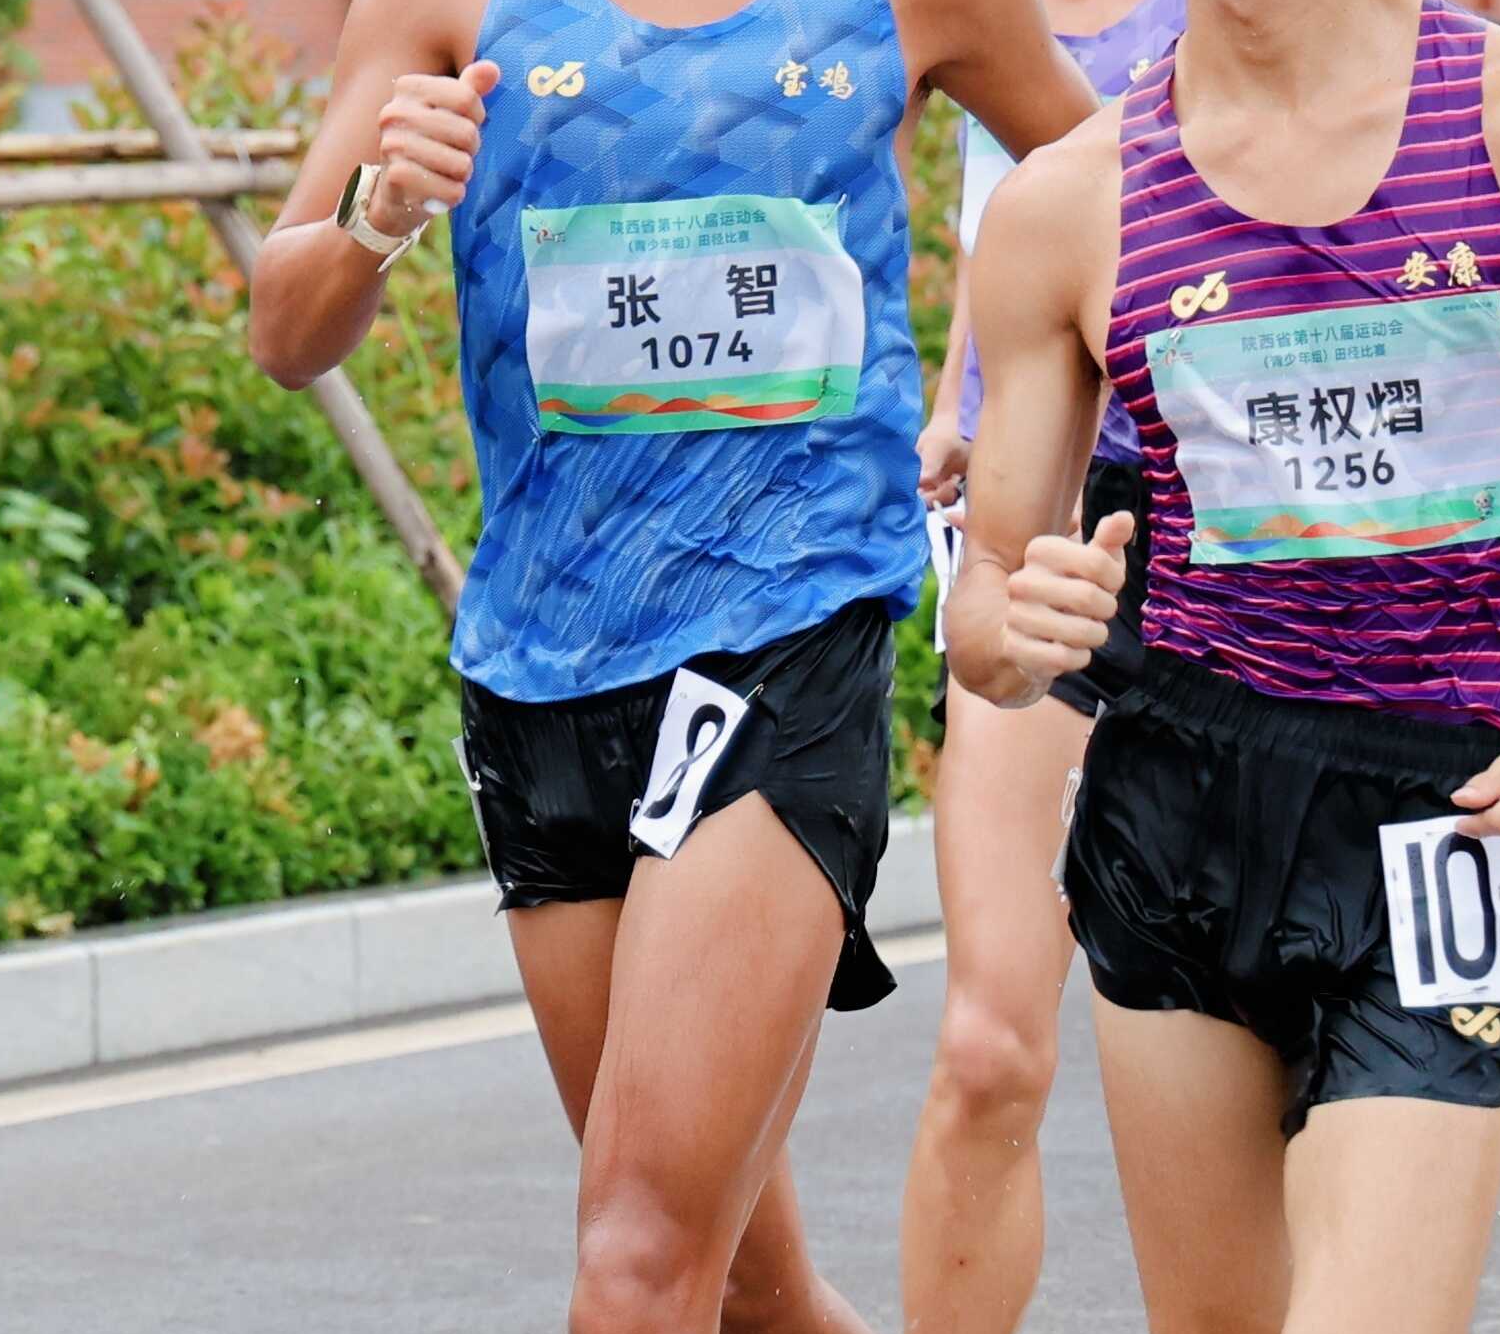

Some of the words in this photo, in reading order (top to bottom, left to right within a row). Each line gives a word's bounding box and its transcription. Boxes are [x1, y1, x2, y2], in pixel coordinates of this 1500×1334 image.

[773, 59, 858, 101] 宝鸡
[609, 209, 768, 236] 陕西省第十八届运动会
[1396, 241, 1482, 291] 安康
[640, 329, 754, 371] 1074
[1240, 319, 1404, 353] 陕西省第十八届运动会
[1246, 378, 1425, 446] 康权熠
[1283, 448, 1396, 491] 1256
[1405, 831, 1498, 986] 10
